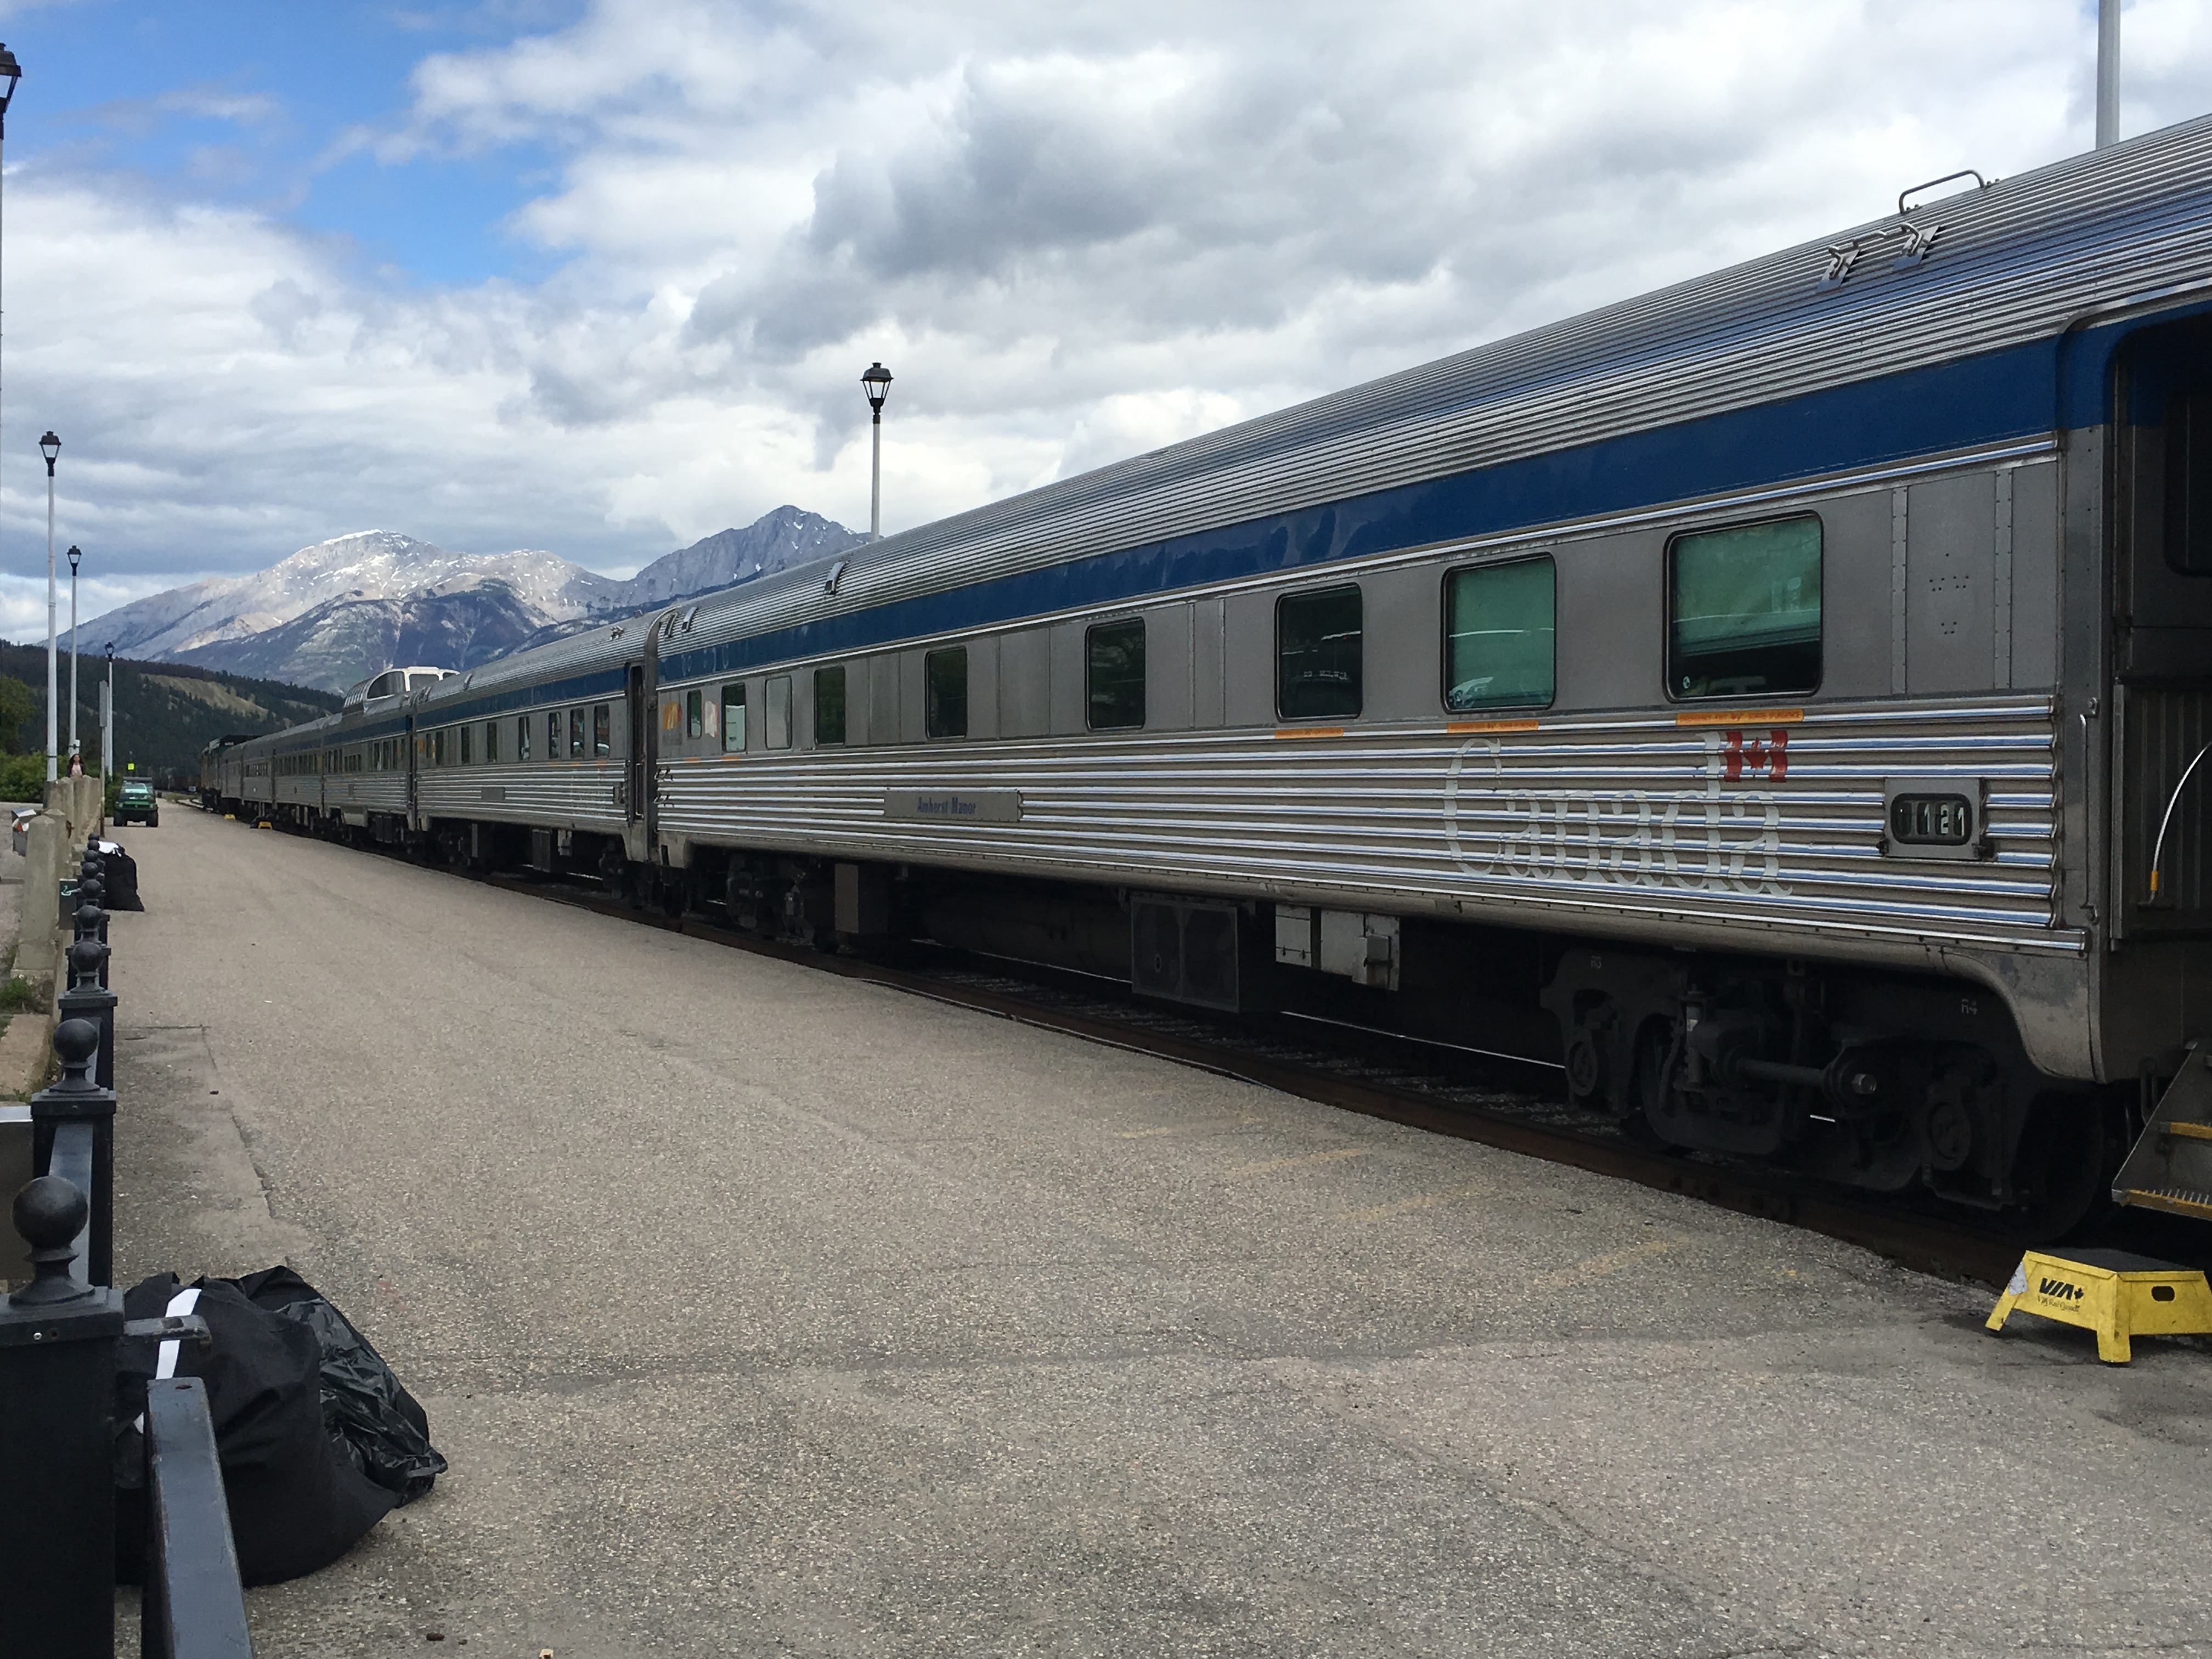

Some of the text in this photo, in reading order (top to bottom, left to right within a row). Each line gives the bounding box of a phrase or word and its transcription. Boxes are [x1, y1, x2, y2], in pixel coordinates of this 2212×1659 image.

[917, 796, 977, 815] Amherst Manor
[1443, 731, 1793, 897] Canada
[1924, 803, 1965, 836] 121
[1961, 998, 1978, 1015] R4
[2039, 1277, 2075, 1301] VIA
